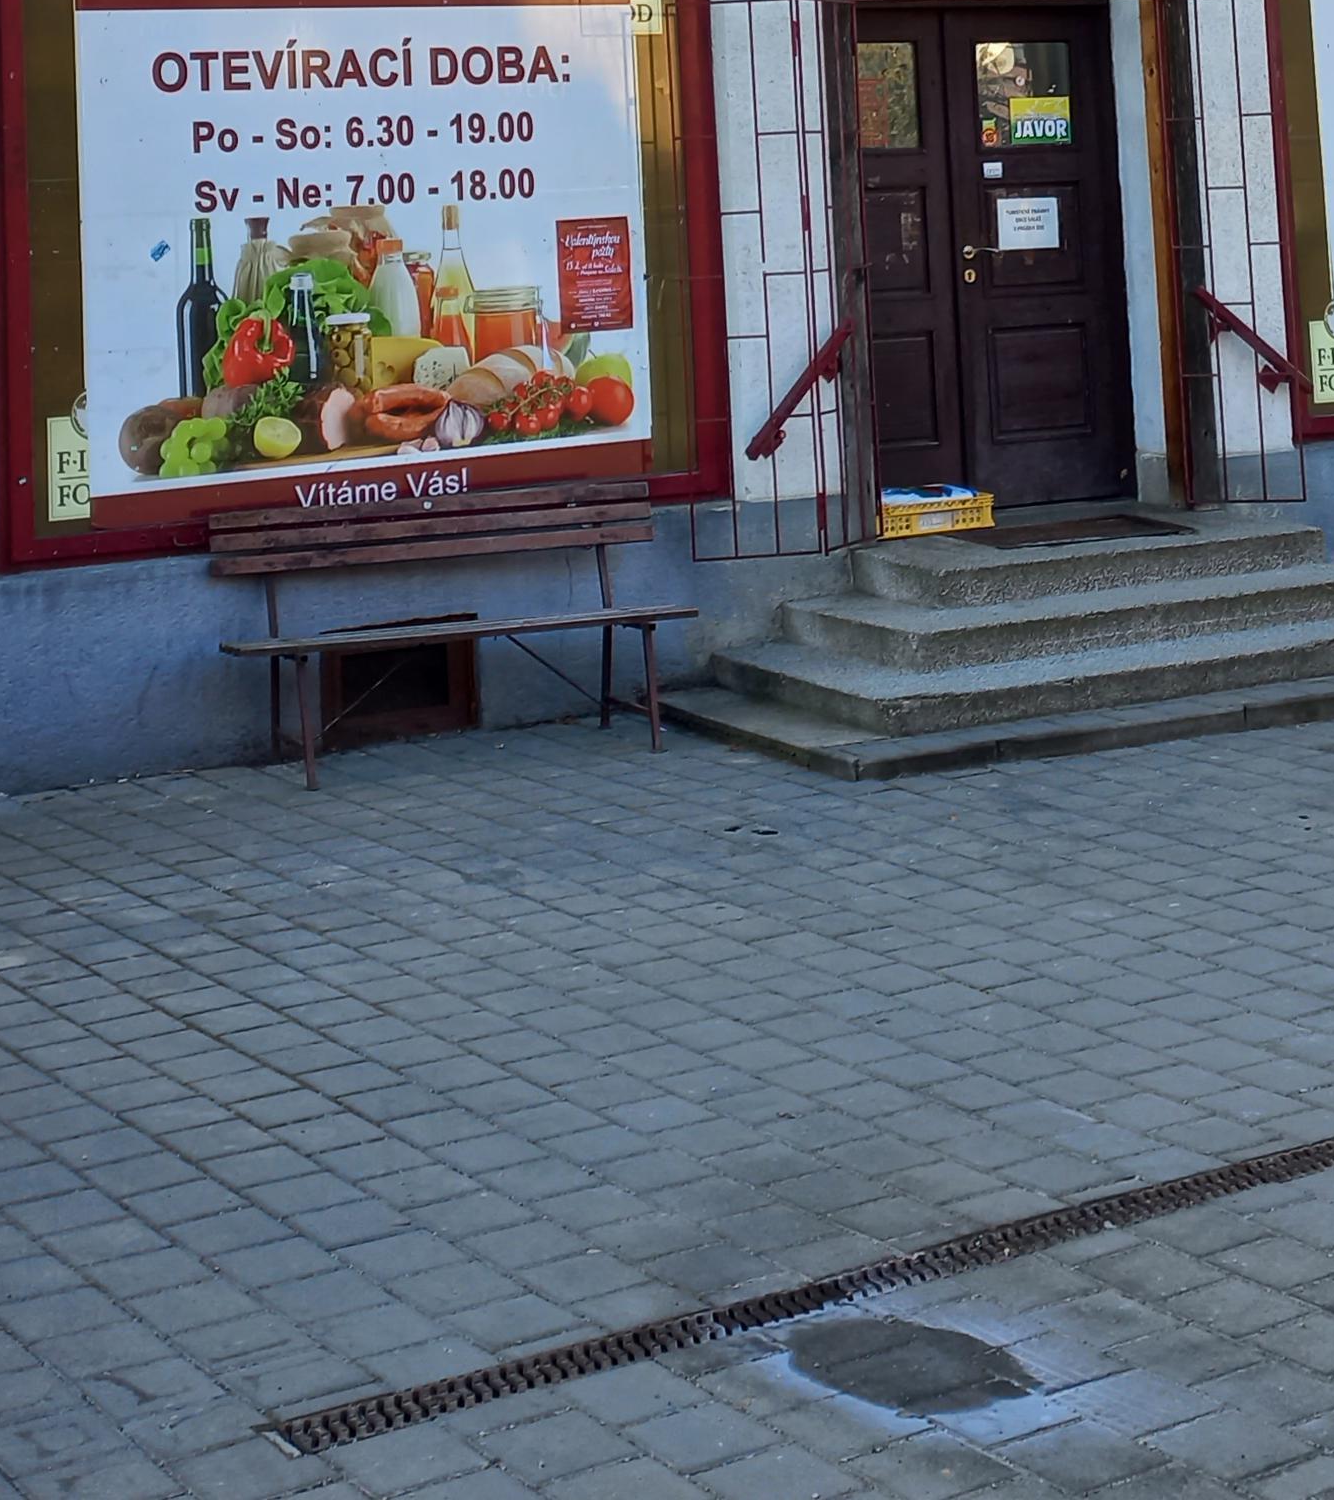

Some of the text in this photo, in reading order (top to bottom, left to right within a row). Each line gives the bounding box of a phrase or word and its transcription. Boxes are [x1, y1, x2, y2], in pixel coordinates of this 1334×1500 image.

[151, 37, 571, 93] OTEVÍRACÍ DOBA:
[192, 121, 239, 154] Po
[275, 117, 332, 151] So:
[345, 114, 414, 149] 6.30
[449, 111, 534, 144] 19.00
[1014, 118, 1068, 139] JAVOR
[194, 180, 240, 214] Sv
[276, 177, 333, 210] Ne:
[346, 172, 415, 206] 7.00
[450, 167, 535, 201] 18.00
[294, 465, 470, 509] Vítáme Vás!
